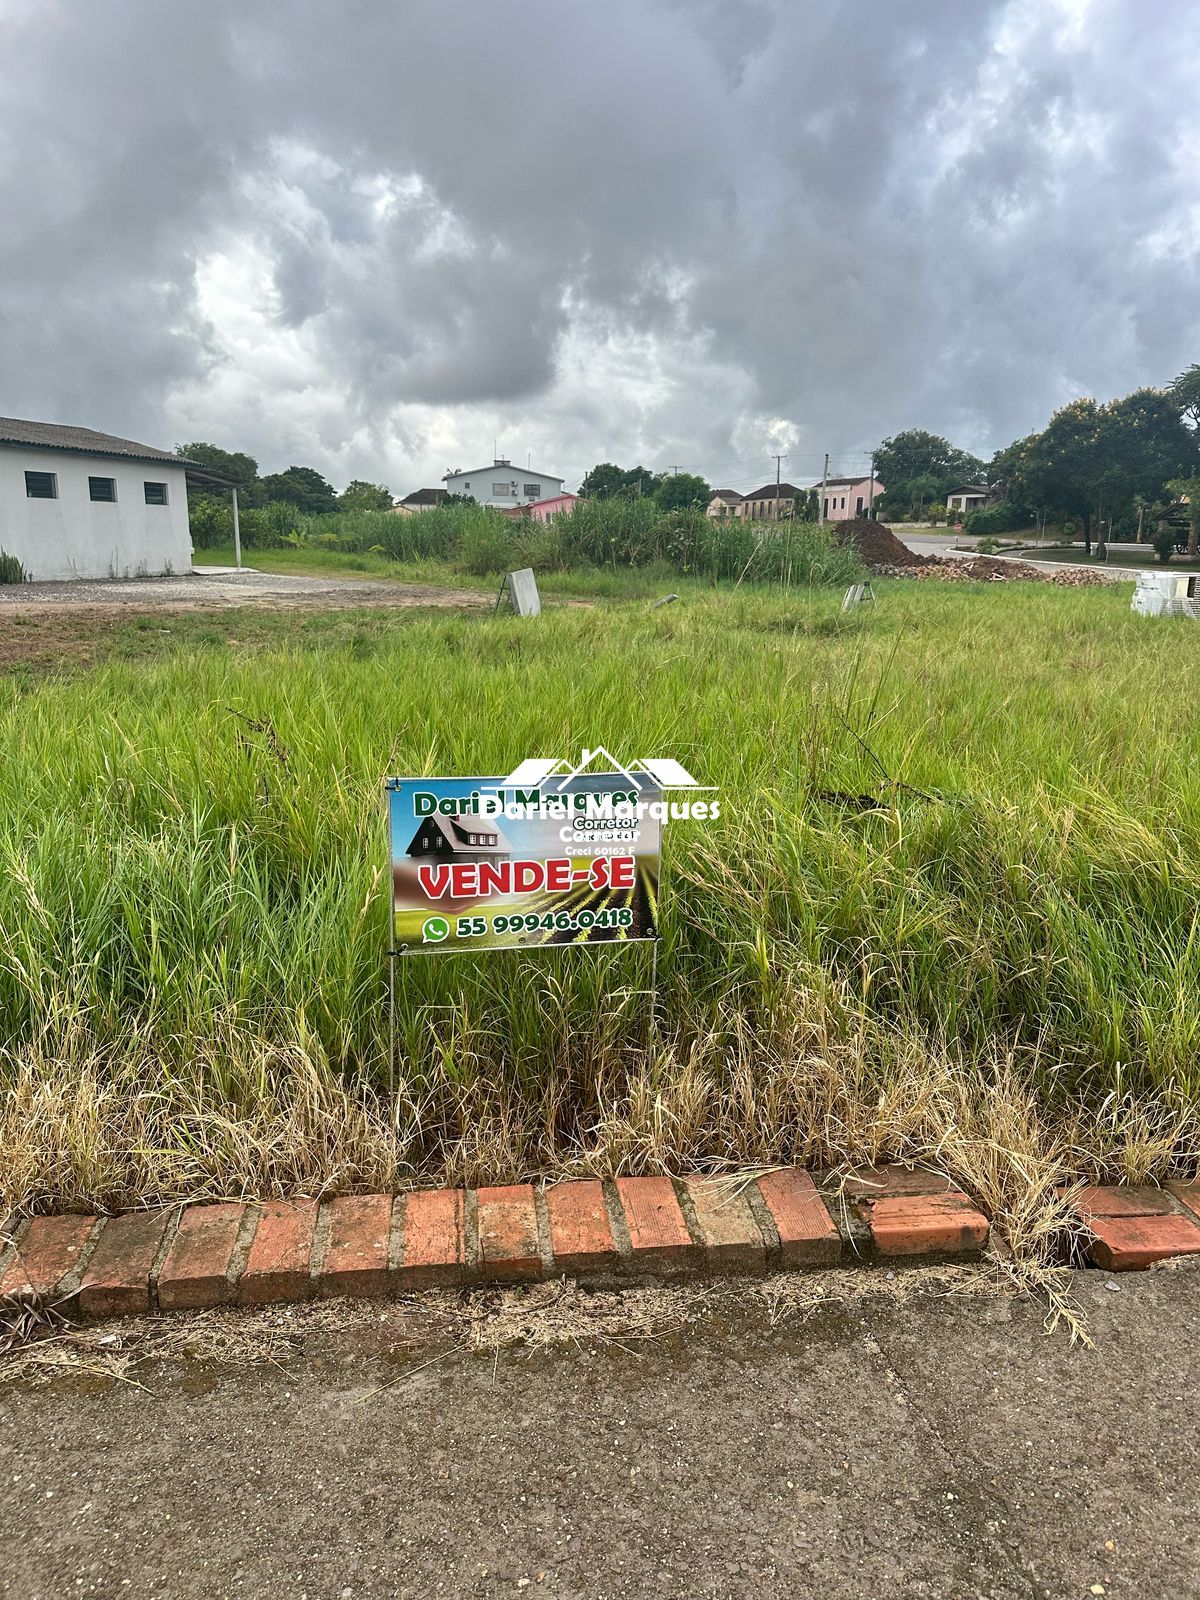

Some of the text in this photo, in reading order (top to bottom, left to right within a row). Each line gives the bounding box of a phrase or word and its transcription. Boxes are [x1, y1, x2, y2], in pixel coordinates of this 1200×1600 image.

[573, 816, 639, 831] Corretor
[417, 856, 636, 899] VENDE-SE
[456, 908, 634, 937] 55 99946.0418
